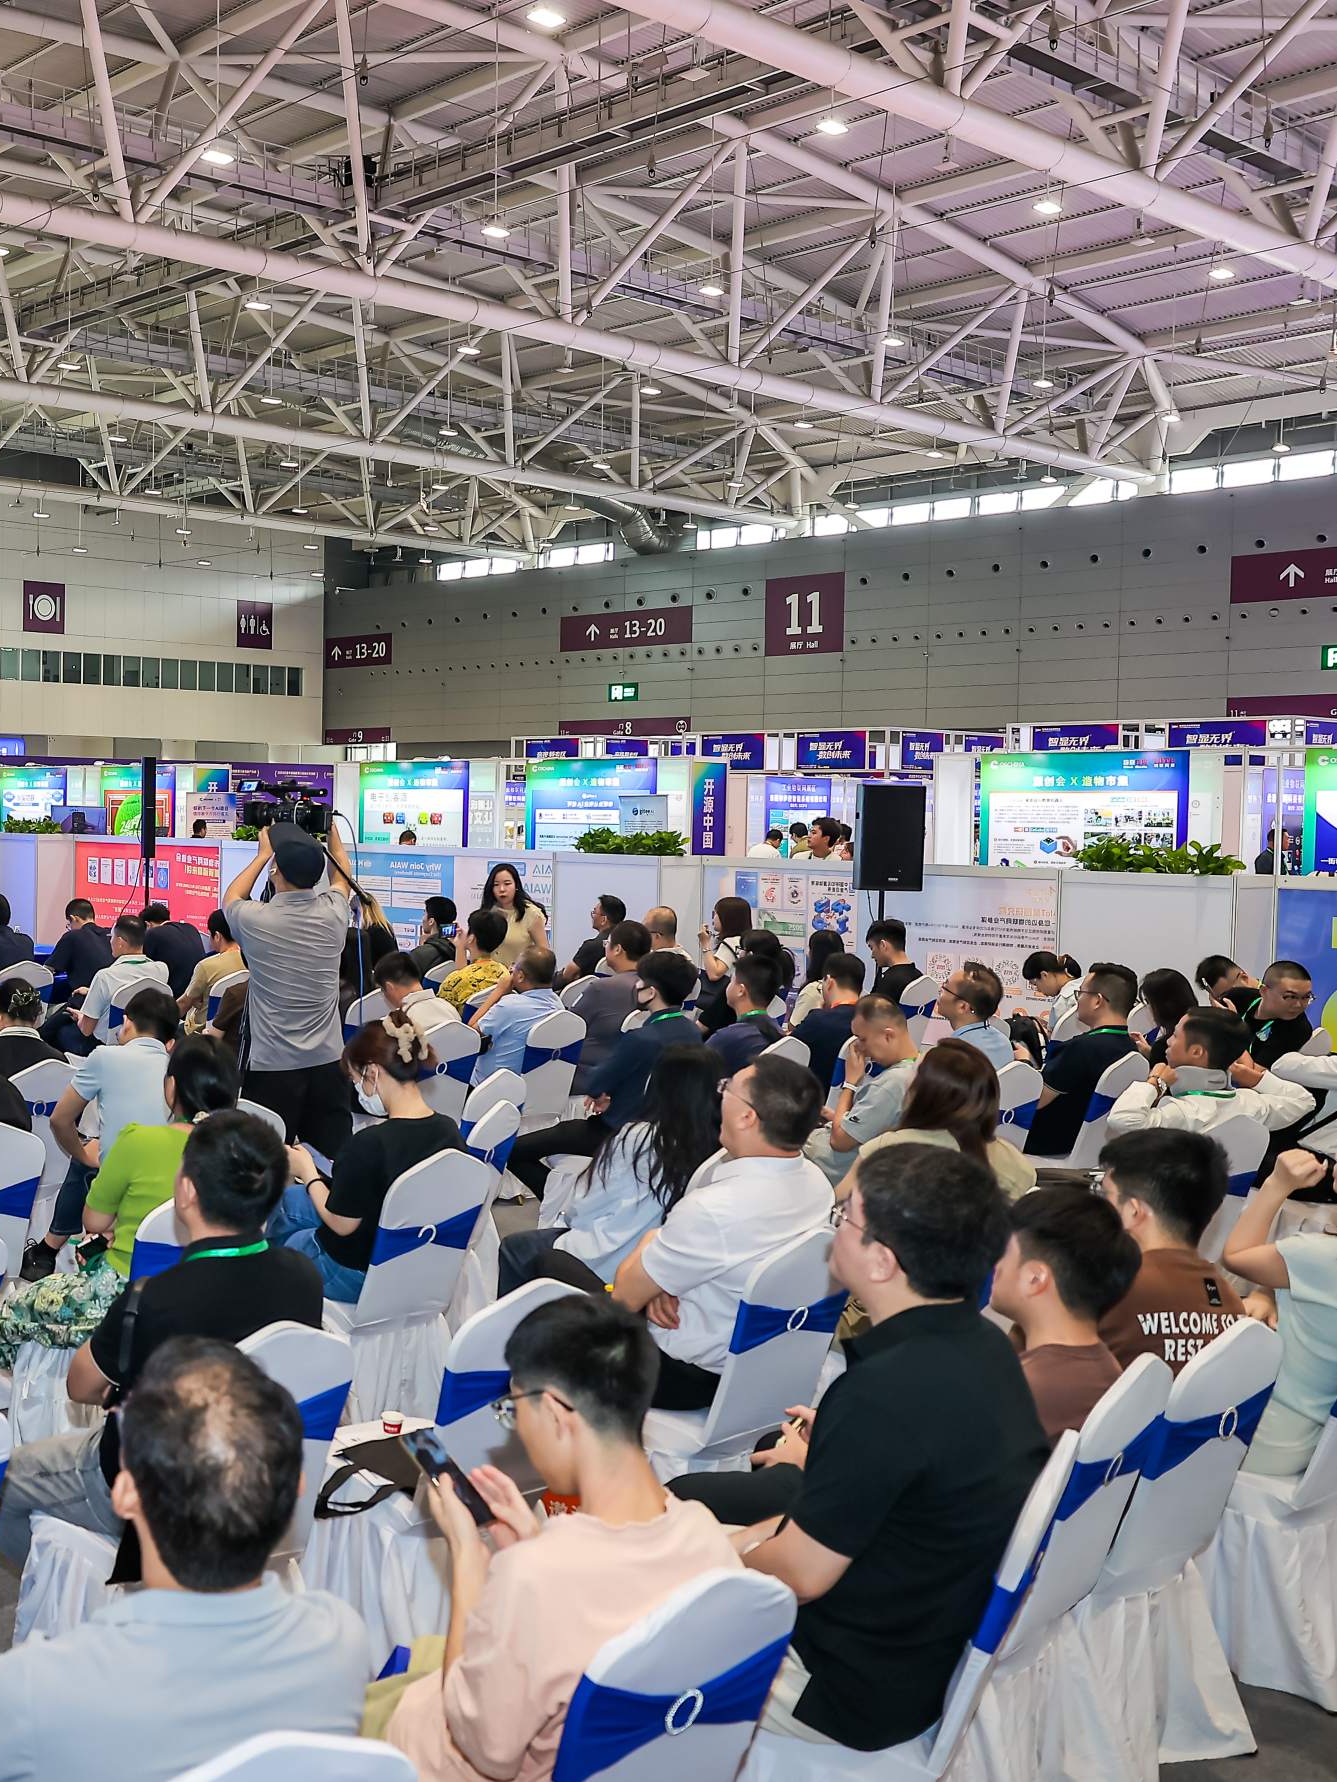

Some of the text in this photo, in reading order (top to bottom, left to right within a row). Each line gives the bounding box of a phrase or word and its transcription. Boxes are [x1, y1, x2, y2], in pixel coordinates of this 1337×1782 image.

[786, 591, 823, 635] 11
[624, 618, 665, 638] 13-20
[355, 641, 386, 659] 13-20
[790, 641, 803, 650] 展厅
[357, 731, 363, 742] 9
[625, 722, 632, 735] 8
[1070, 776, 1078, 786] X
[703, 778, 714, 849] 开源中国
[1137, 1311, 1218, 1336] WELCOME
